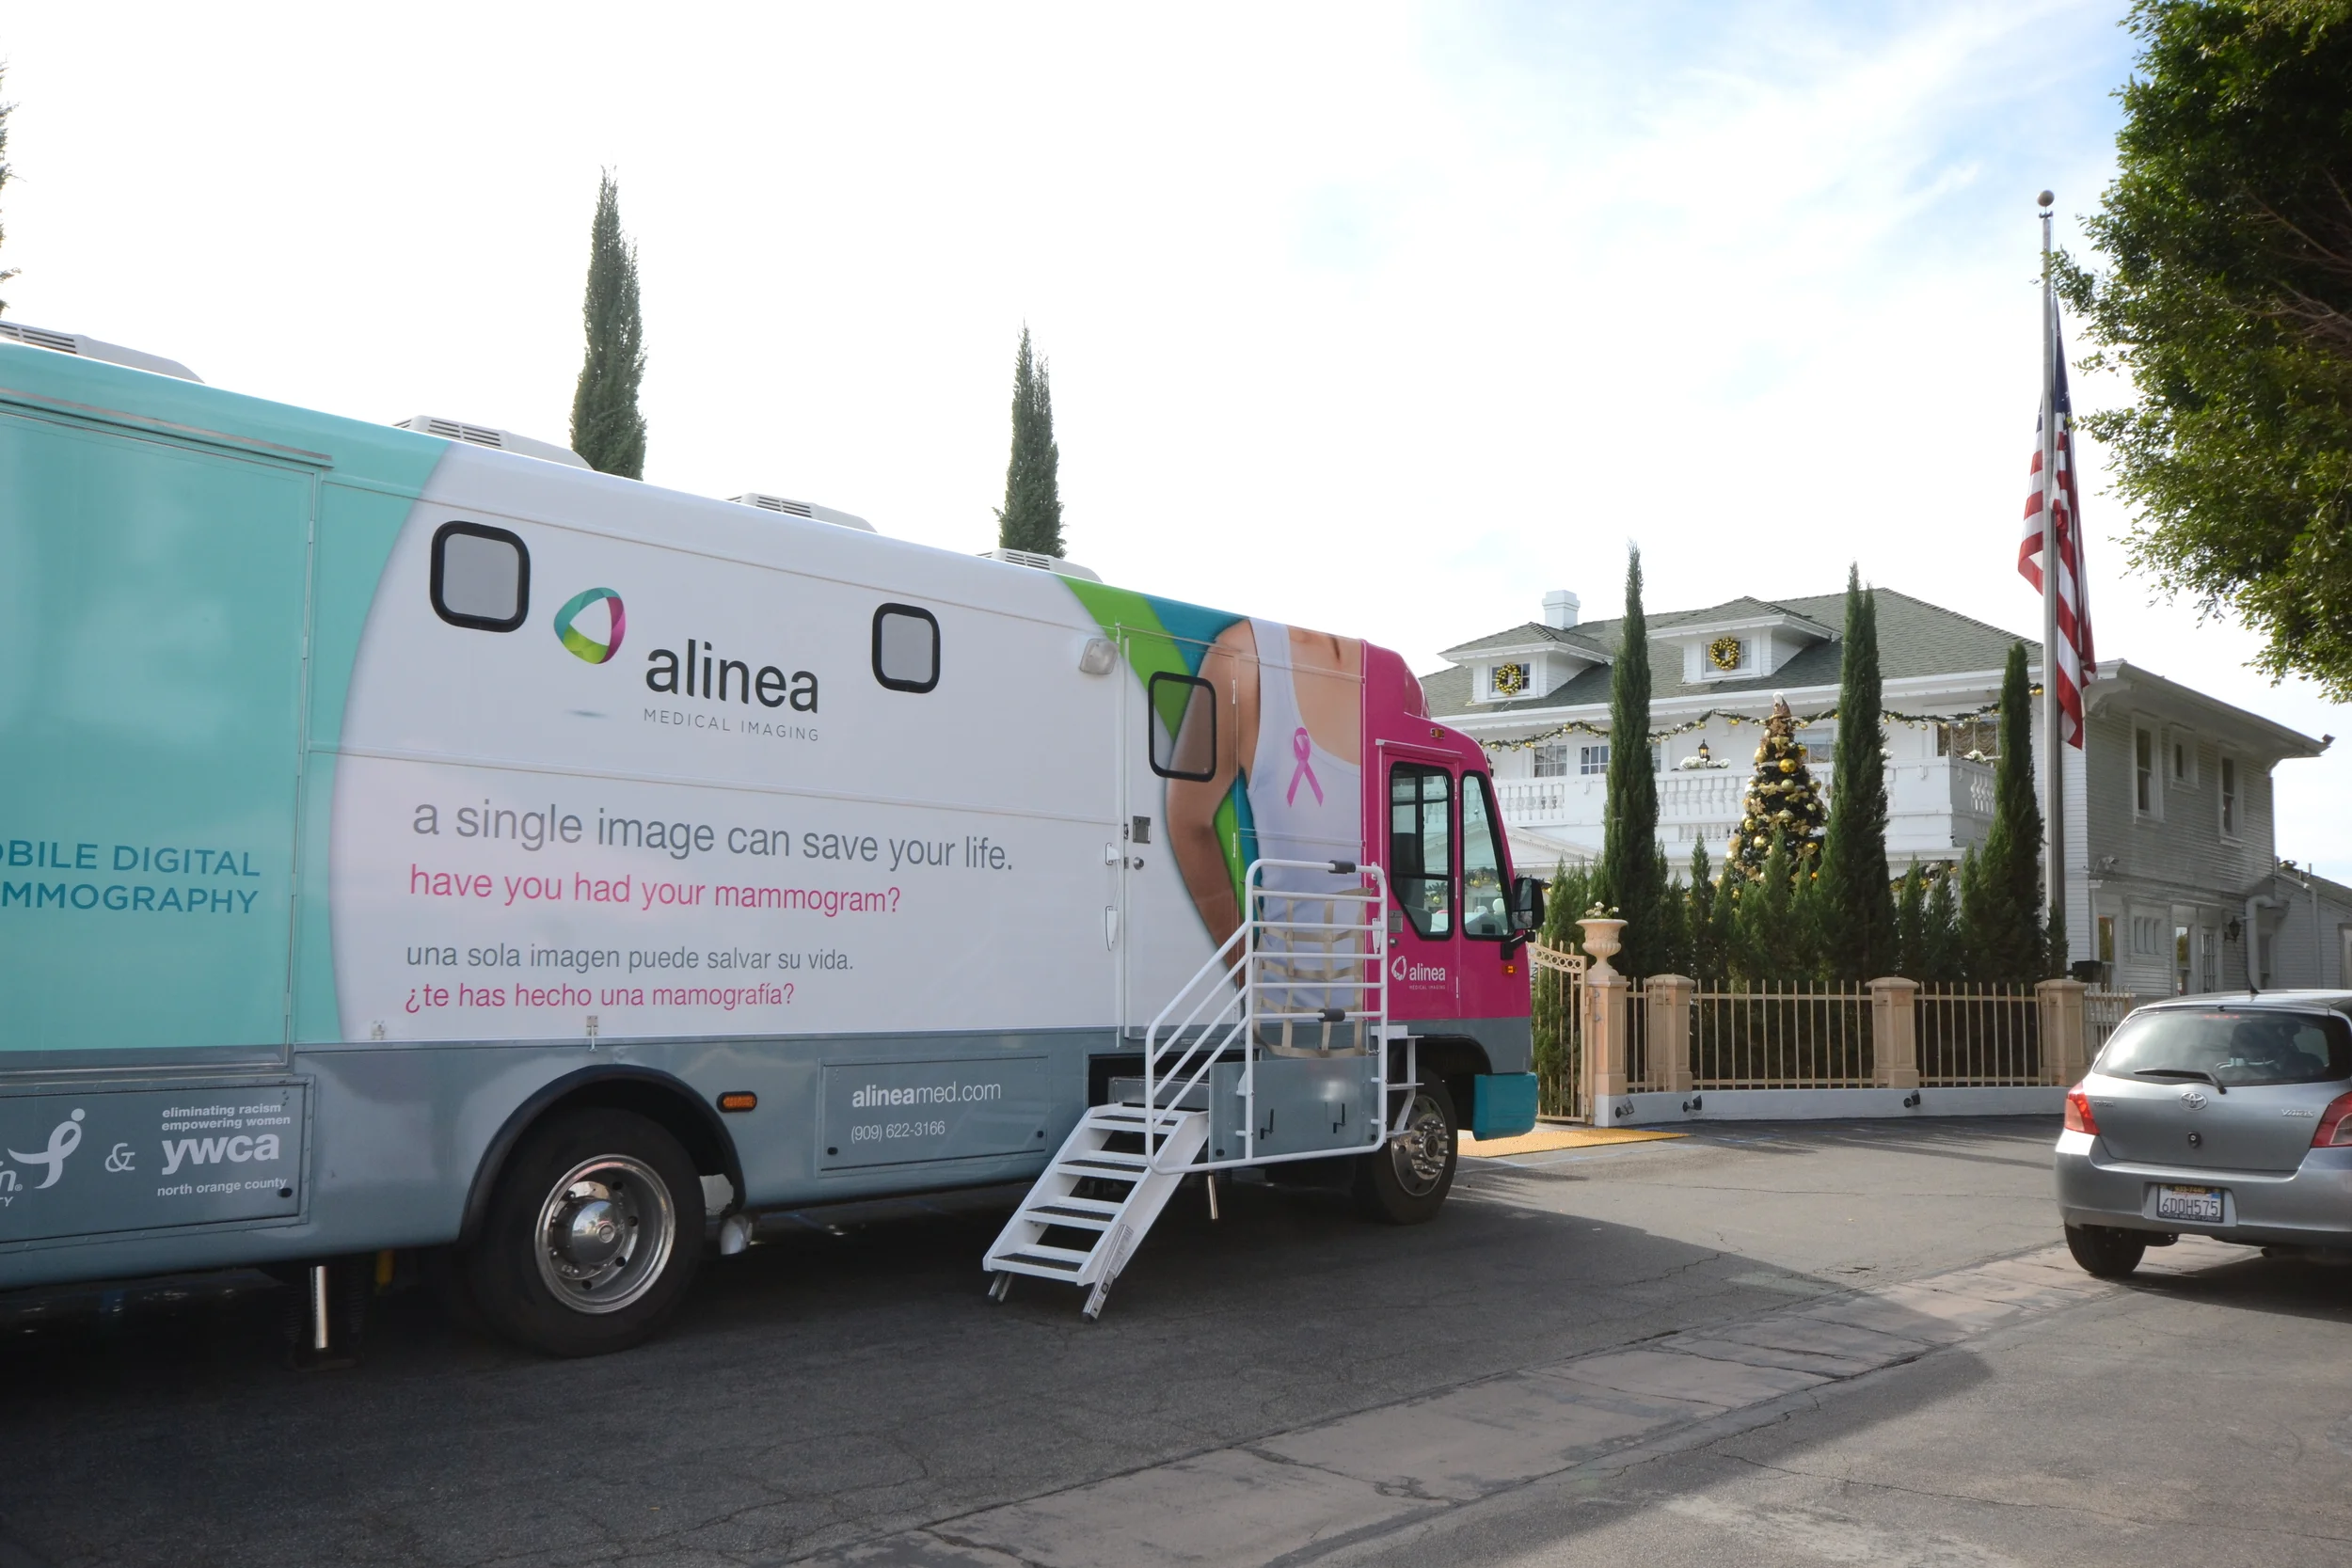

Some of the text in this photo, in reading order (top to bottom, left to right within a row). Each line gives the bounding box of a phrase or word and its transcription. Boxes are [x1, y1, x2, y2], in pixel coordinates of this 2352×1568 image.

[645, 638, 818, 714] alinea
[644, 708, 818, 741] MEDICAL IMAGING
[412, 799, 1012, 872] a single image can save your life.
[0, 839, 261, 877] BILE DIGITAL
[410, 863, 900, 917] have you had your mammogram?
[406, 942, 853, 974] una sola imagen puede salvar su vida.
[1408, 962, 1446, 981] alinea
[405, 983, 795, 1013] ¿te has hecho una mamografía?
[851, 1081, 1001, 1108] alineamed.com
[161, 1116, 291, 1132] empowering women
[162, 1103, 281, 1118] eliminating racism
[850, 1120, 946, 1144] (909) 622-3166
[104, 1142, 135, 1173] &
[161, 1133, 279, 1176] ywca
[157, 1178, 288, 1196] north orange county
